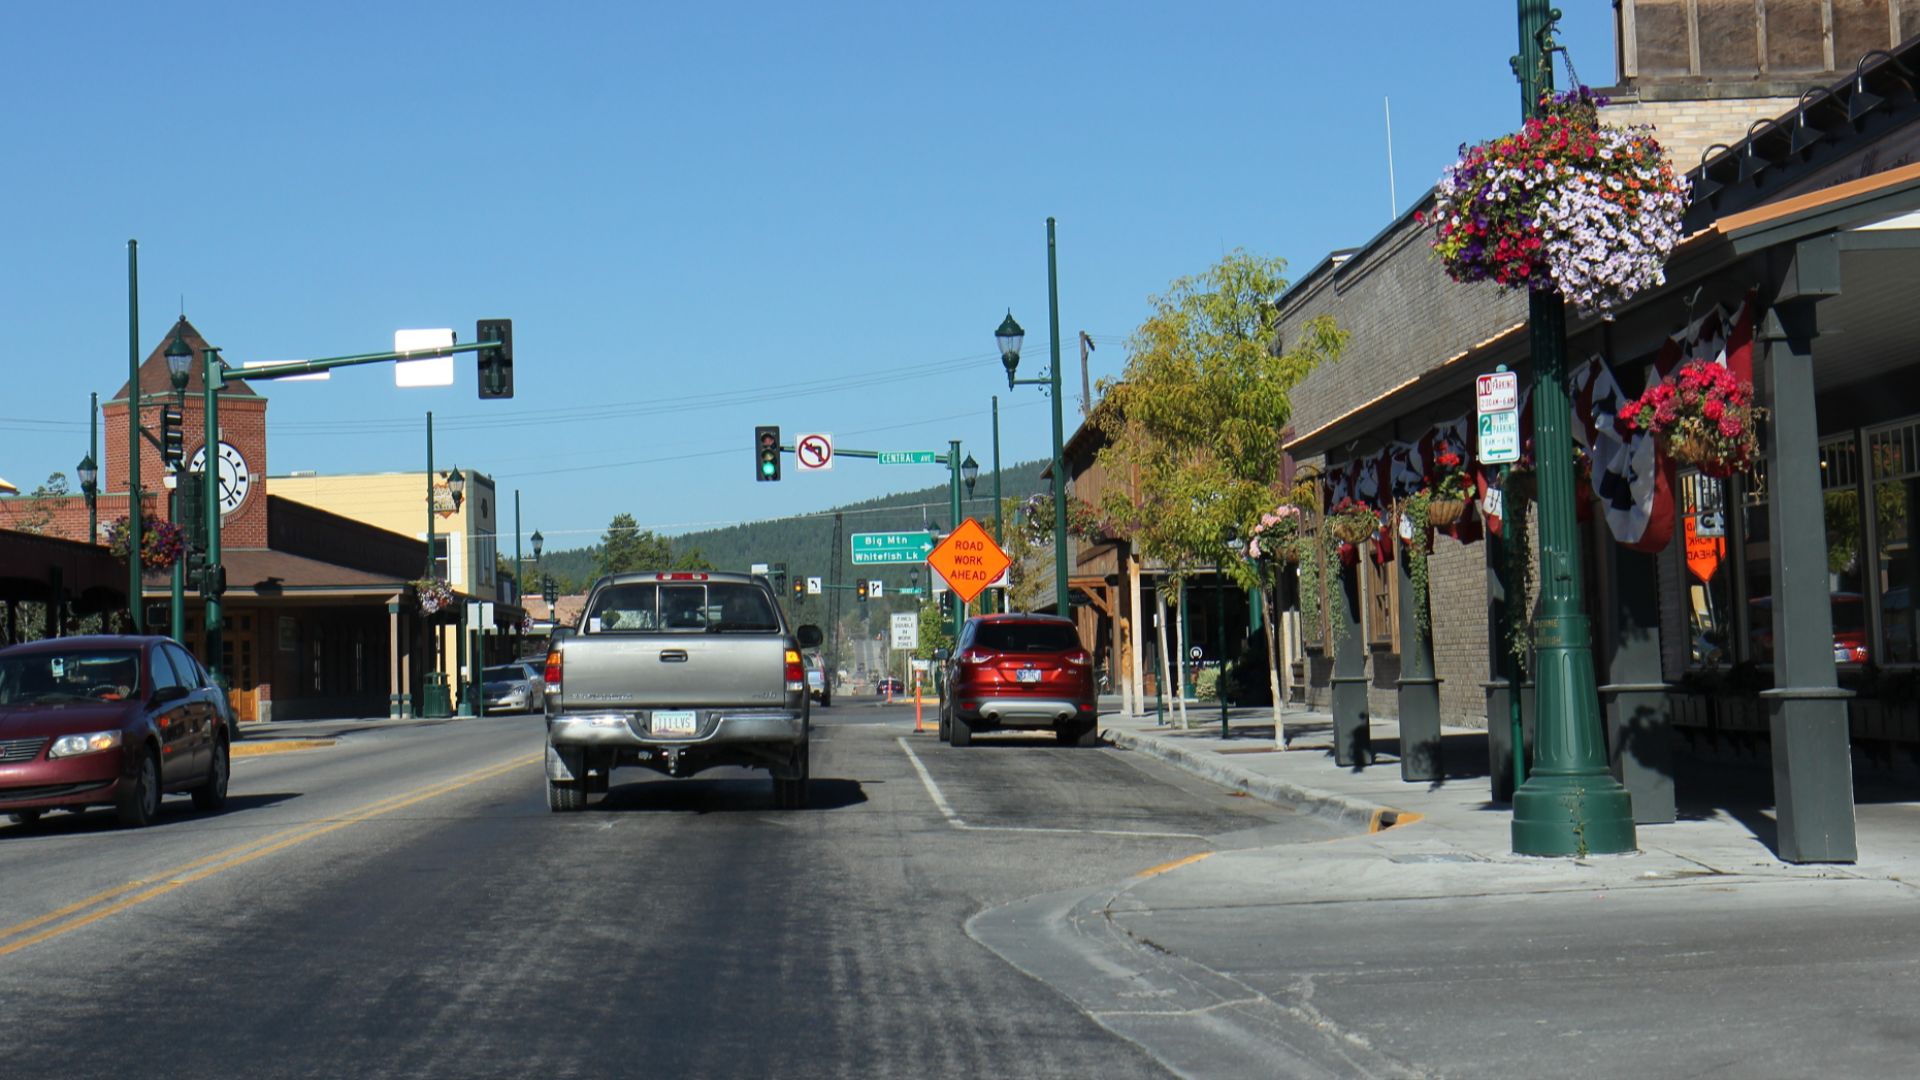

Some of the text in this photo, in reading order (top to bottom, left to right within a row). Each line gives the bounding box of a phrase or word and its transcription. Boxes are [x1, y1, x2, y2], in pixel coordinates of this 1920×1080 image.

[1479, 379, 1514, 395] NO PARKING
[1482, 416, 1491, 435] 2
[1493, 423, 1516, 434] PARKING
[881, 453, 932, 463] CENTRAL AVE
[865, 536, 908, 547] Big Mtn
[955, 540, 984, 551] ROAD
[855, 551, 918, 561] Whitefish Lk
[954, 555, 983, 565] WORK
[950, 570, 987, 581] AHEAD
